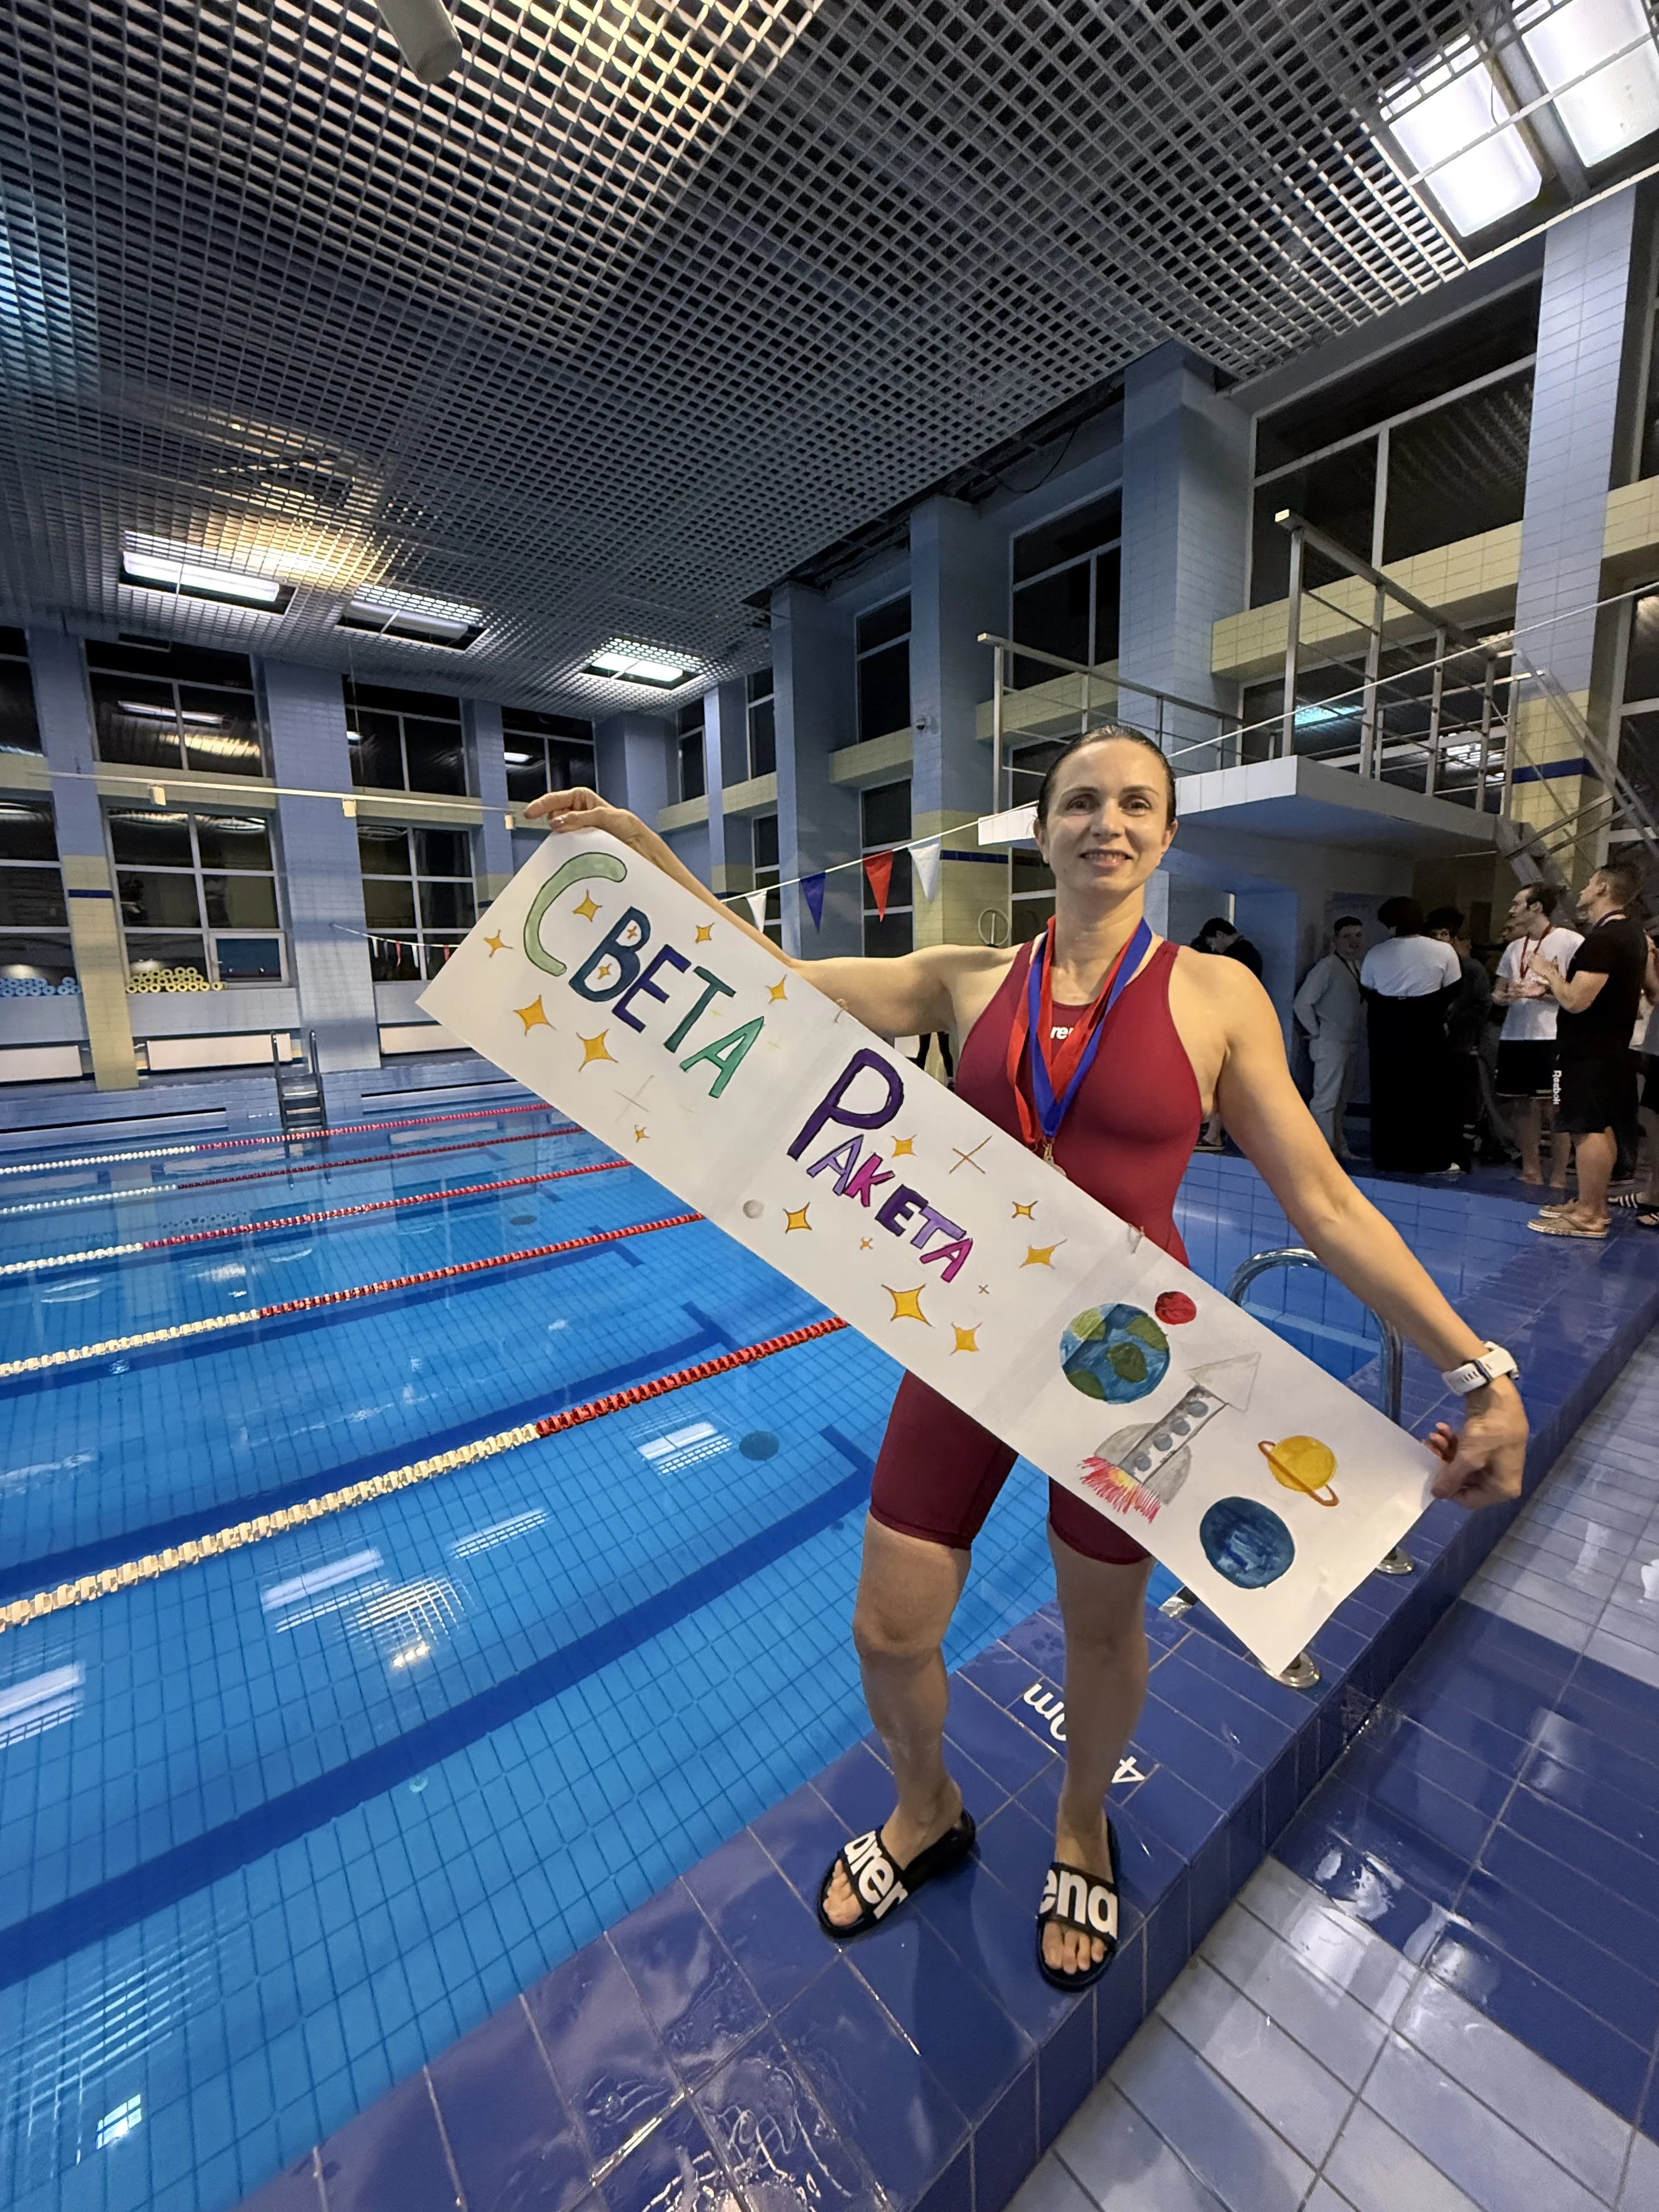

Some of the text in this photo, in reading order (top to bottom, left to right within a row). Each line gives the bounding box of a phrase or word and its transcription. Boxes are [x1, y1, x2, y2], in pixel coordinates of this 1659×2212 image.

[523, 852, 973, 1283] СВЕТА РАКЕТА
[1551, 1070, 1562, 1105] Reebok
